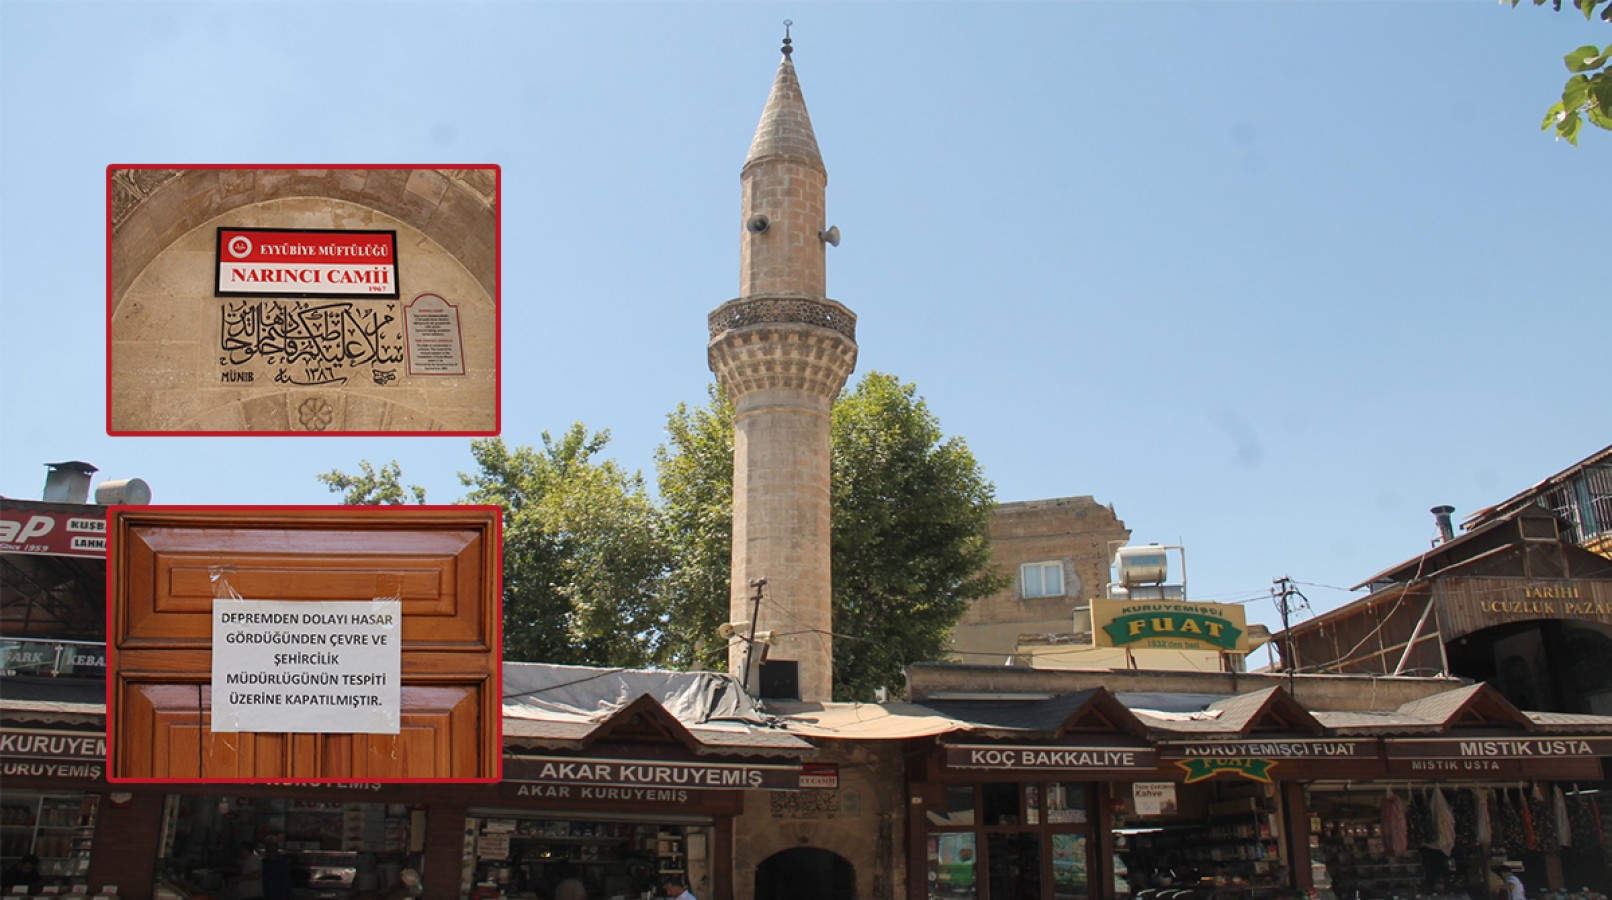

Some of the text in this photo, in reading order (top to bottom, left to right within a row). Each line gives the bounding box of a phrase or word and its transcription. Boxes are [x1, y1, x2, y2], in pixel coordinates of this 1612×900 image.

[260, 243, 388, 257] EYYÜBİYE MÜFTÜLÜĞÜ
[231, 266, 389, 284] NARINCI CAMİİ
[71, 520, 106, 530] KUŞB
[74, 539, 106, 548] LAHM
[1481, 601, 1556, 613] UCUZLUK
[222, 613, 393, 625] DEPREMDEN DOLAYI HASAR
[1127, 617, 1224, 638] FUAT
[226, 631, 388, 647] GÖRDÜĞÜNDEN ÇEVRE VE
[274, 651, 340, 666] ŞEHİRCİLİK
[342, 673, 387, 685] TESPİTİ
[229, 692, 383, 708] ÜZERİNE KAPATILMIŞTIR.
[1184, 742, 1357, 757] KURUYEMİŞÇİ FUAT
[1460, 740, 1593, 756] MISTIK USTA
[971, 750, 1136, 767] KOÇ BAKKALİYE
[1411, 760, 1501, 770] MISTIK USTA
[539, 762, 764, 788] AKAR KURUYEMİŞ
[517, 784, 689, 803] AKAR KURUYEMİŞ
